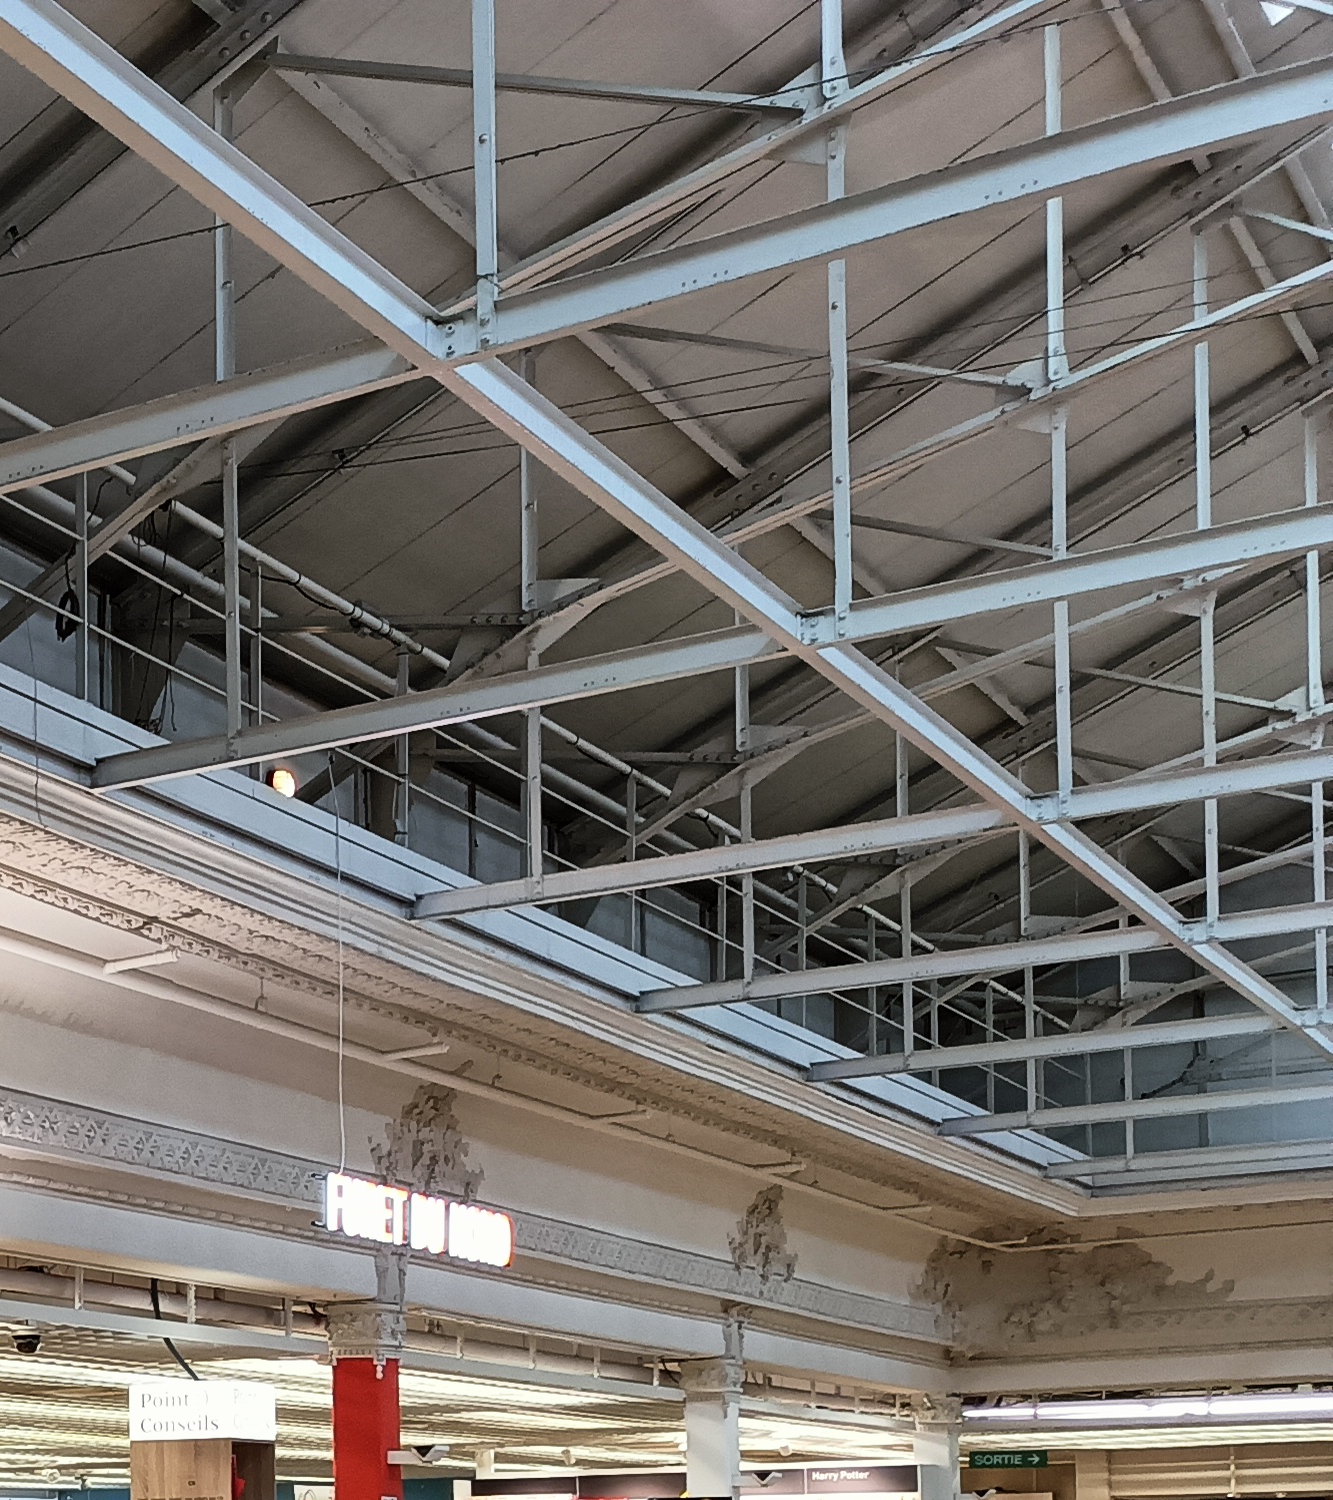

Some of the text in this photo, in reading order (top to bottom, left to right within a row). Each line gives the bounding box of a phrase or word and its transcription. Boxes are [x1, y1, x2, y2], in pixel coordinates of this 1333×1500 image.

[141, 1391, 189, 1409] Point
[140, 1414, 220, 1434] Conseils
[974, 1453, 1023, 1466] SORTIE
[811, 1470, 870, 1483] Harry Potter
